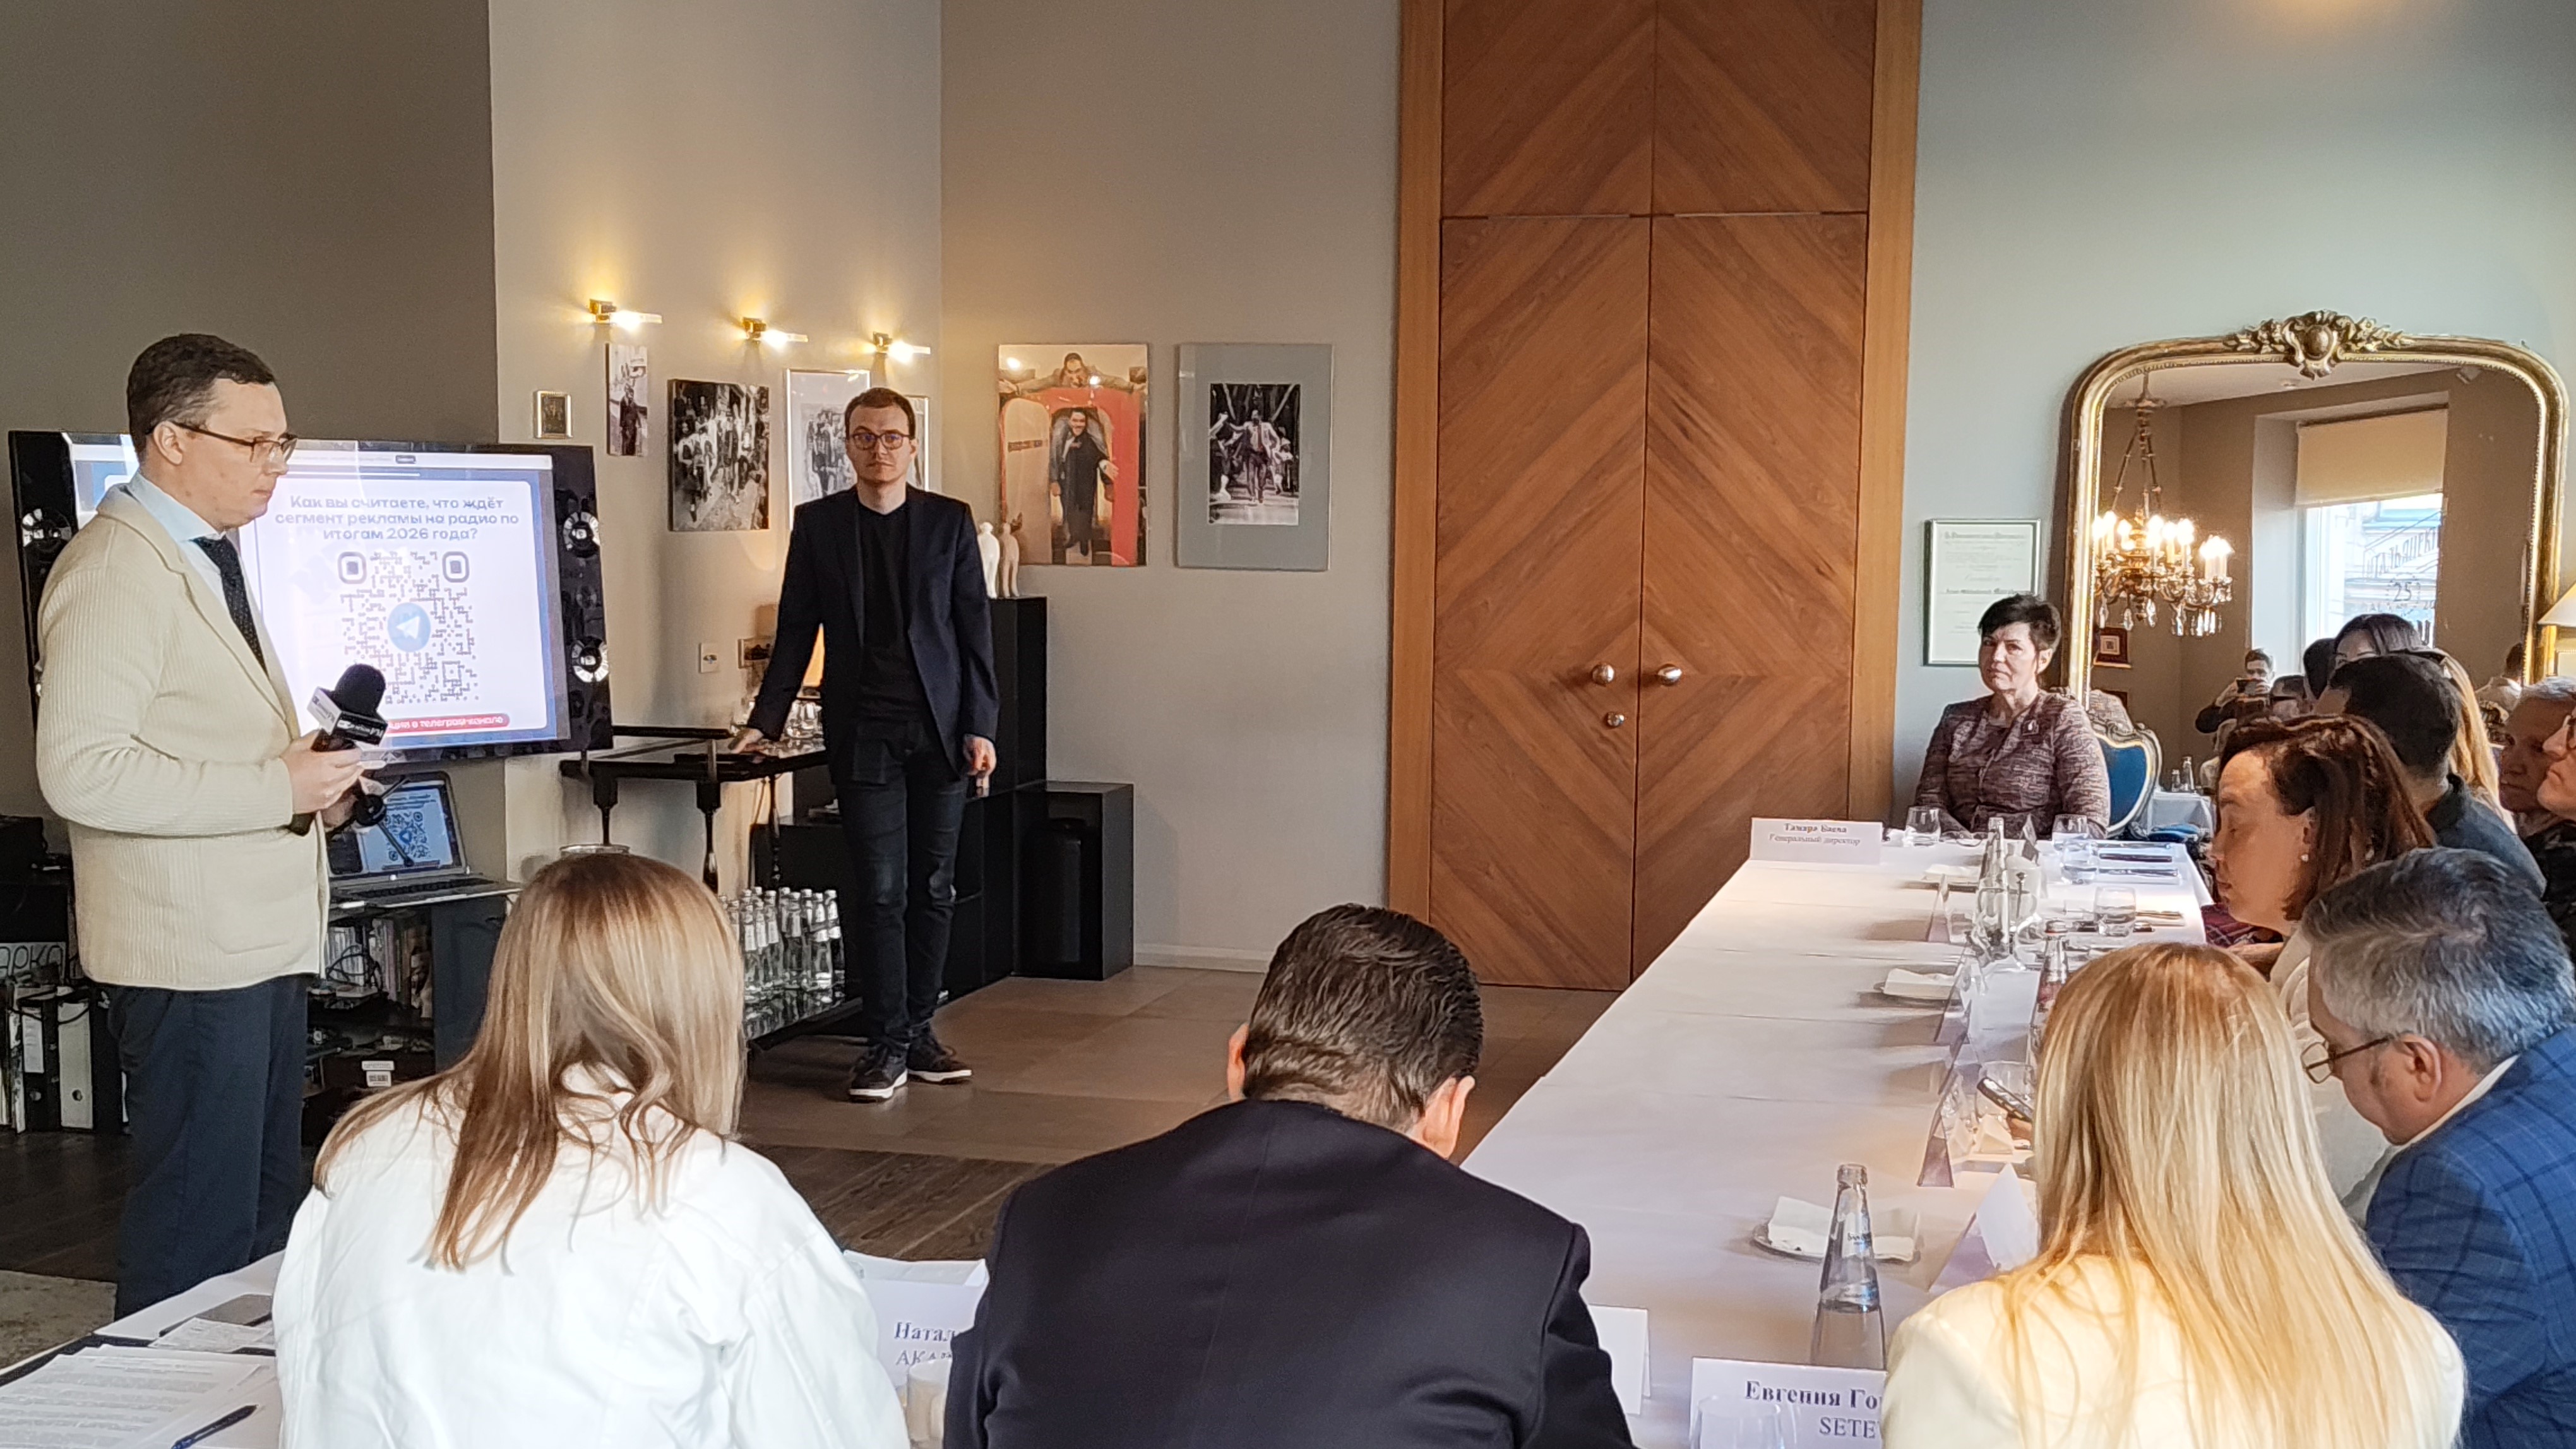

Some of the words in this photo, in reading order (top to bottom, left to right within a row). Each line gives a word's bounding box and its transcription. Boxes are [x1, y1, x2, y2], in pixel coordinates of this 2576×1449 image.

[290, 496, 323, 508] Как
[325, 498, 349, 508] вы
[351, 498, 429, 510] считаете,
[432, 499, 459, 509] что
[463, 496, 504, 510] ждёт
[275, 514, 343, 524] сегмент
[348, 515, 422, 526] рекламы
[426, 515, 444, 524] на
[448, 515, 498, 526] радио
[500, 515, 519, 524] по
[323, 529, 384, 540] итогам
[386, 528, 429, 540] 2026
[432, 528, 478, 541] года?
[1745, 1381, 1840, 1407] Евгения
[1850, 1388, 1882, 1410] Го
[1819, 1416, 1880, 1440] SETE
